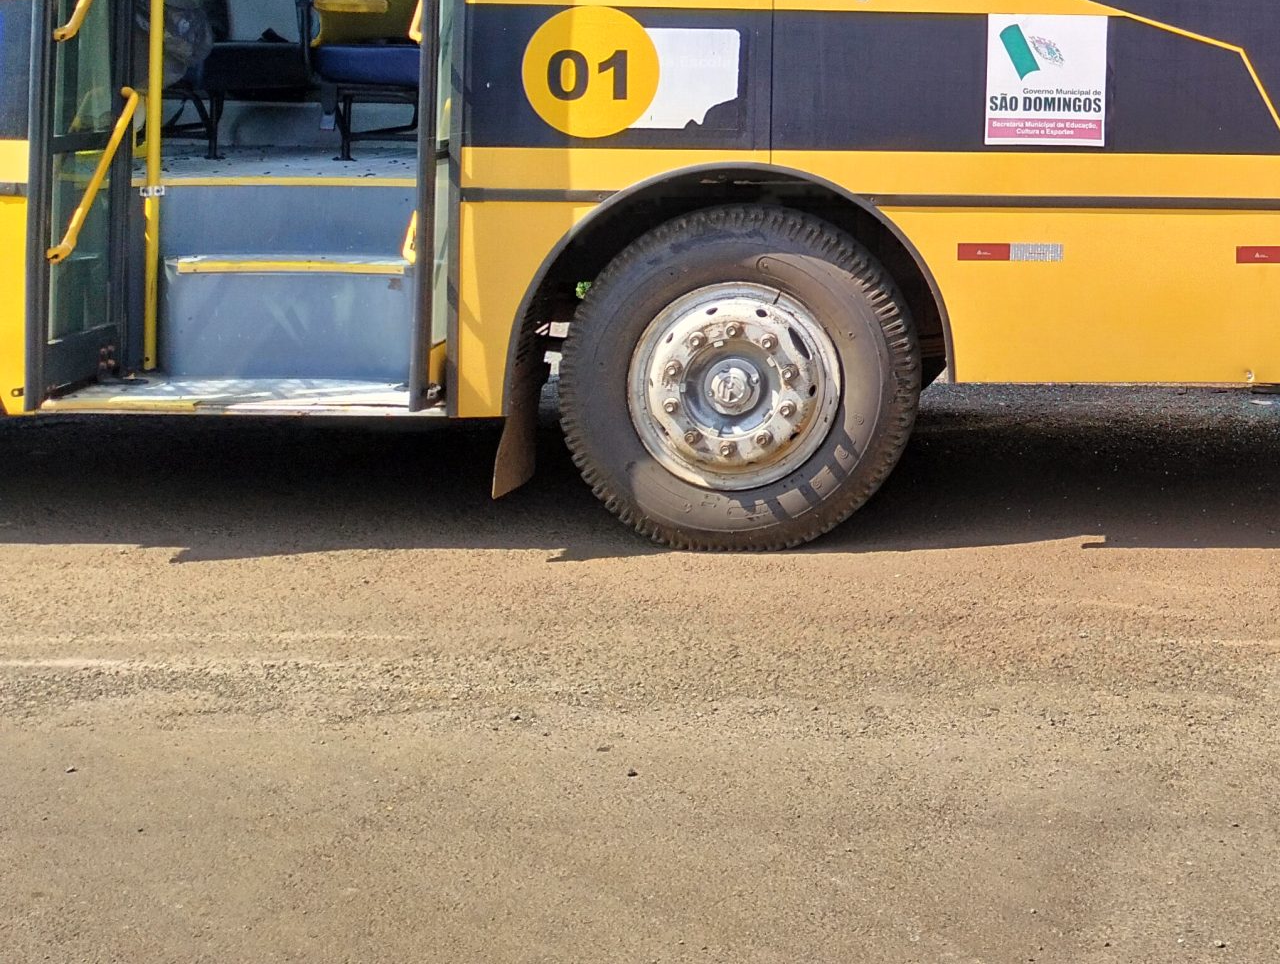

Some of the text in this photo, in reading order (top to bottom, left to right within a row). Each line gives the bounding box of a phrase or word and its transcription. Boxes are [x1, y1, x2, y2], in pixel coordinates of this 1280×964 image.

[546, 50, 628, 101] 01
[989, 93, 1102, 113] SÃO DOMINGOS
[1056, 89, 1090, 97] Municipal
